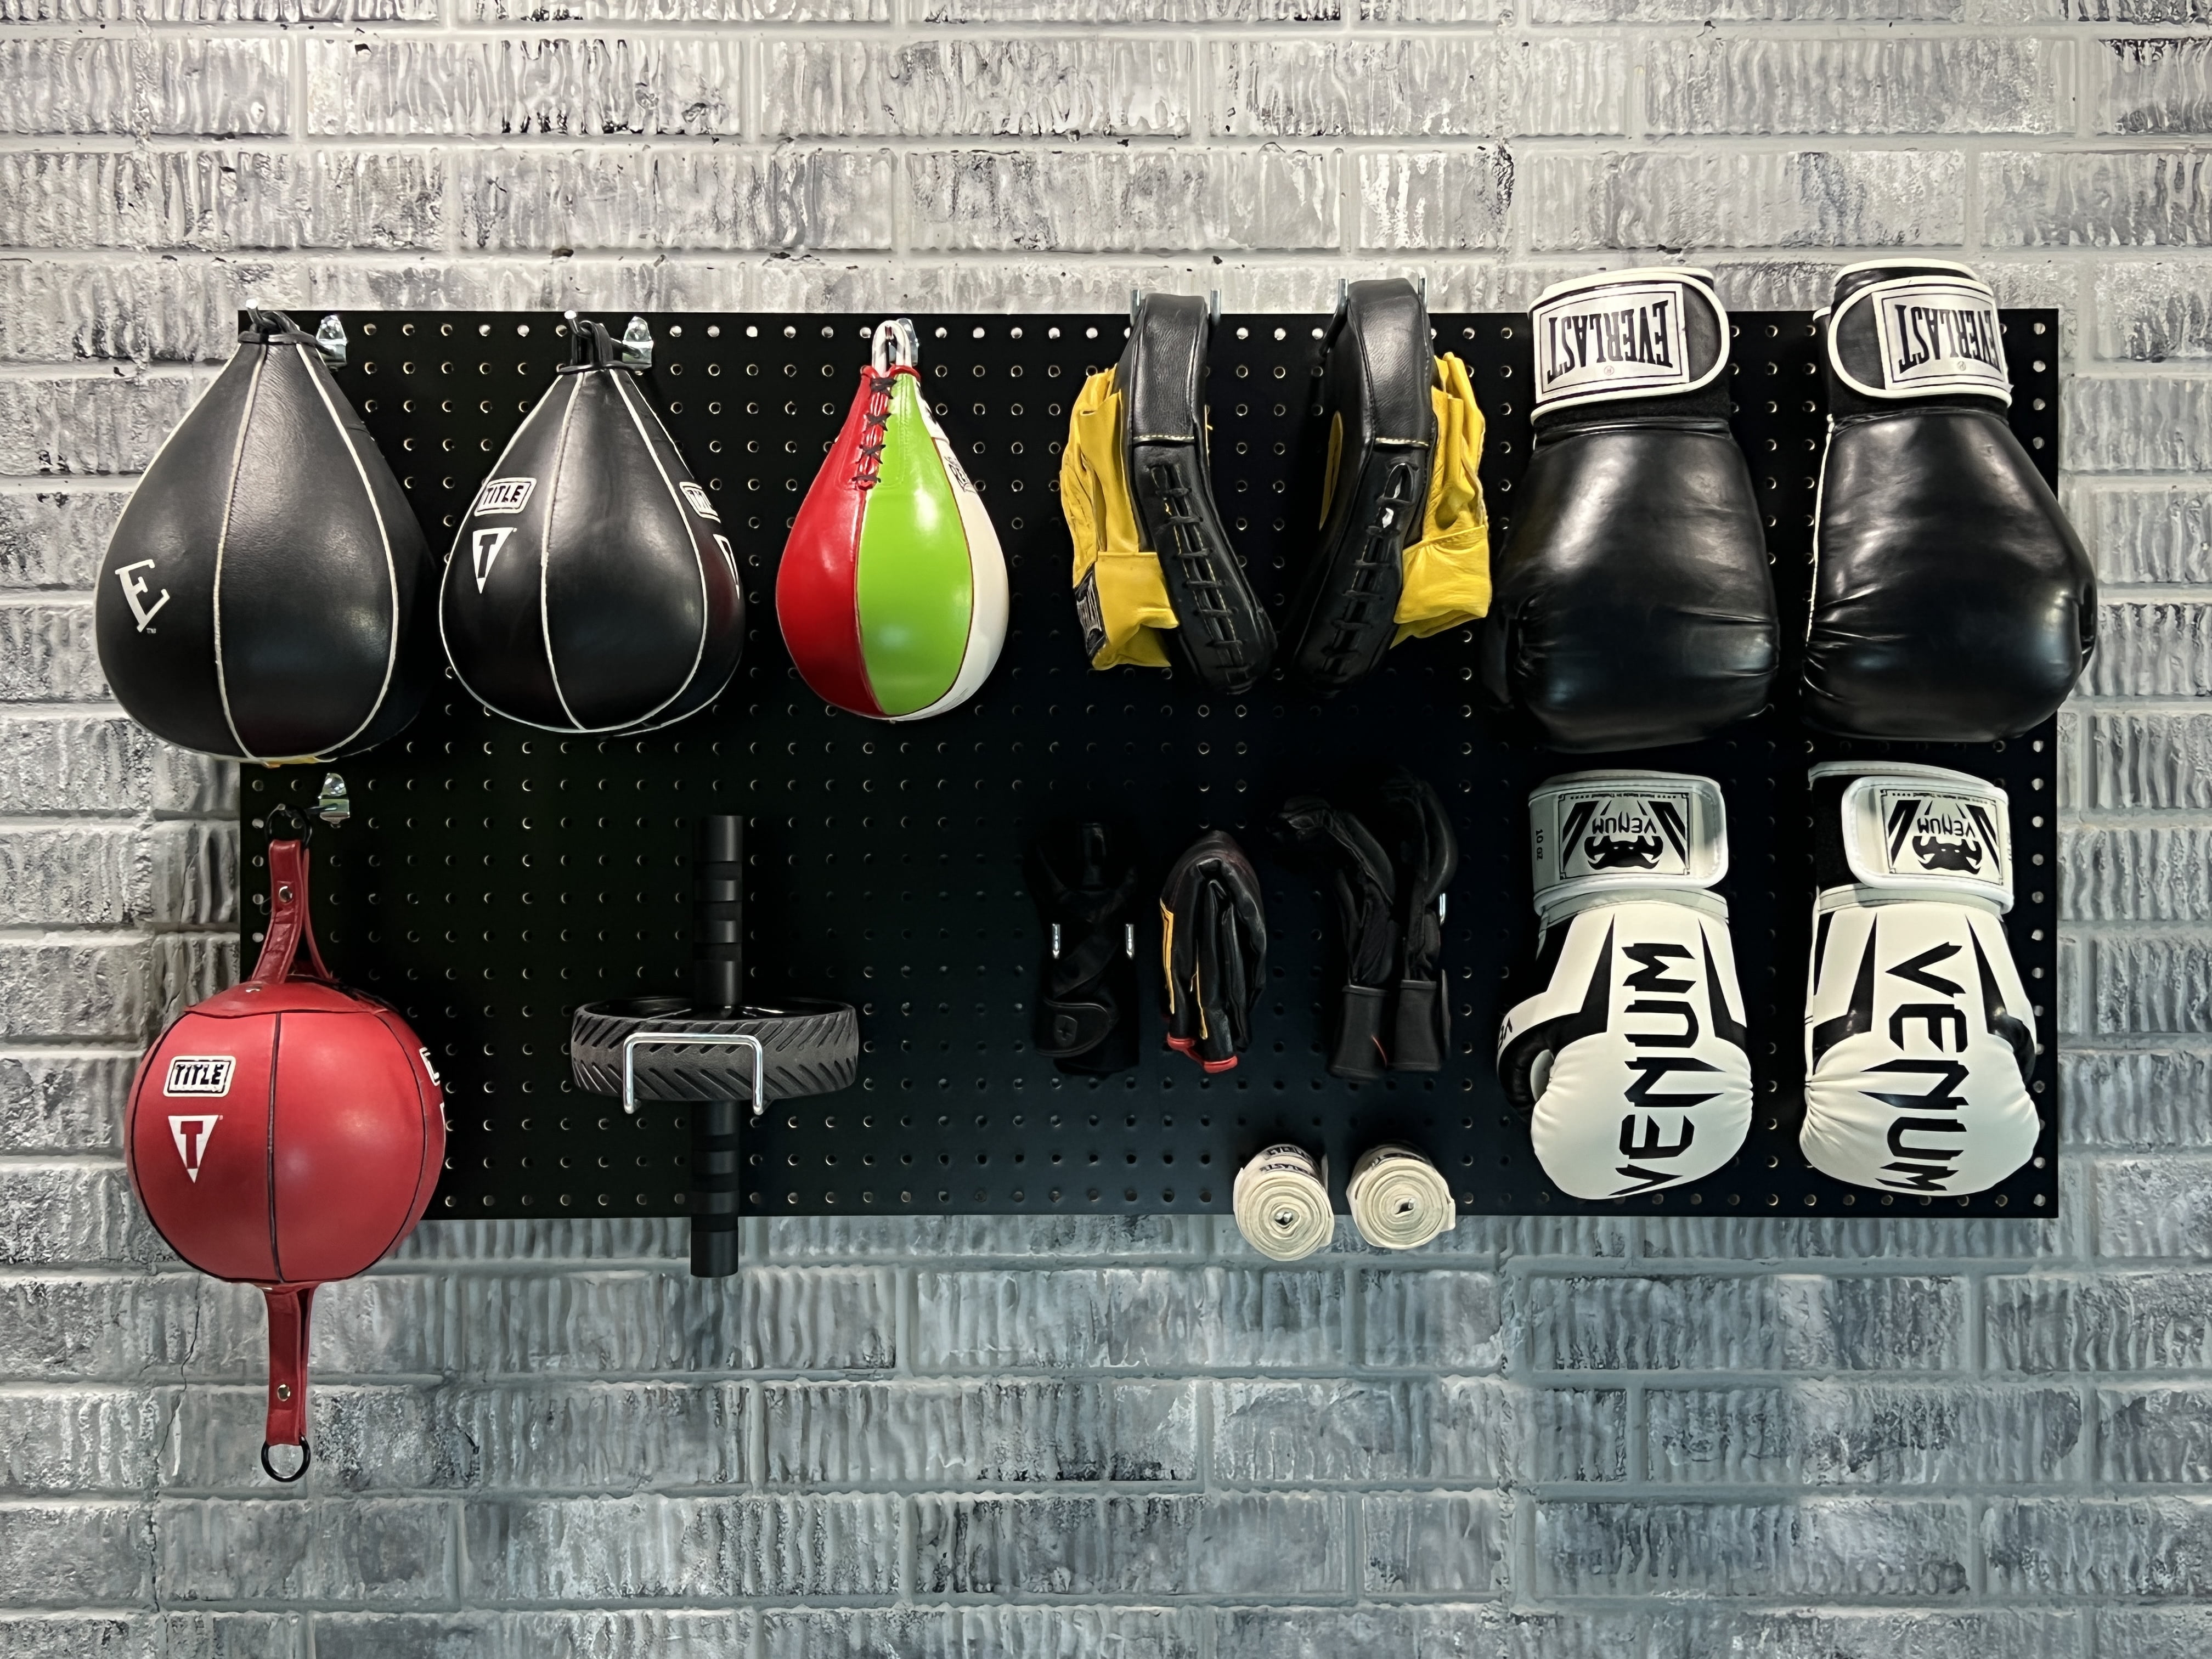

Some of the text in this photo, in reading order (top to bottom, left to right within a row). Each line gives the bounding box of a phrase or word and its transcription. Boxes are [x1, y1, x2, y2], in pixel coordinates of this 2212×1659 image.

[1547, 300, 1673, 384] EVERLAST
[1894, 304, 2002, 374] EVERLAST
[483, 486, 524, 505] TITLE
[1592, 811, 1657, 834] VENUM
[1917, 813, 1975, 838] VENUM
[1536, 829, 1543, 843] 10
[174, 1064, 224, 1085] TITLE
[1608, 943, 1726, 1197] VENUM
[1857, 941, 1970, 1191] VENUM
